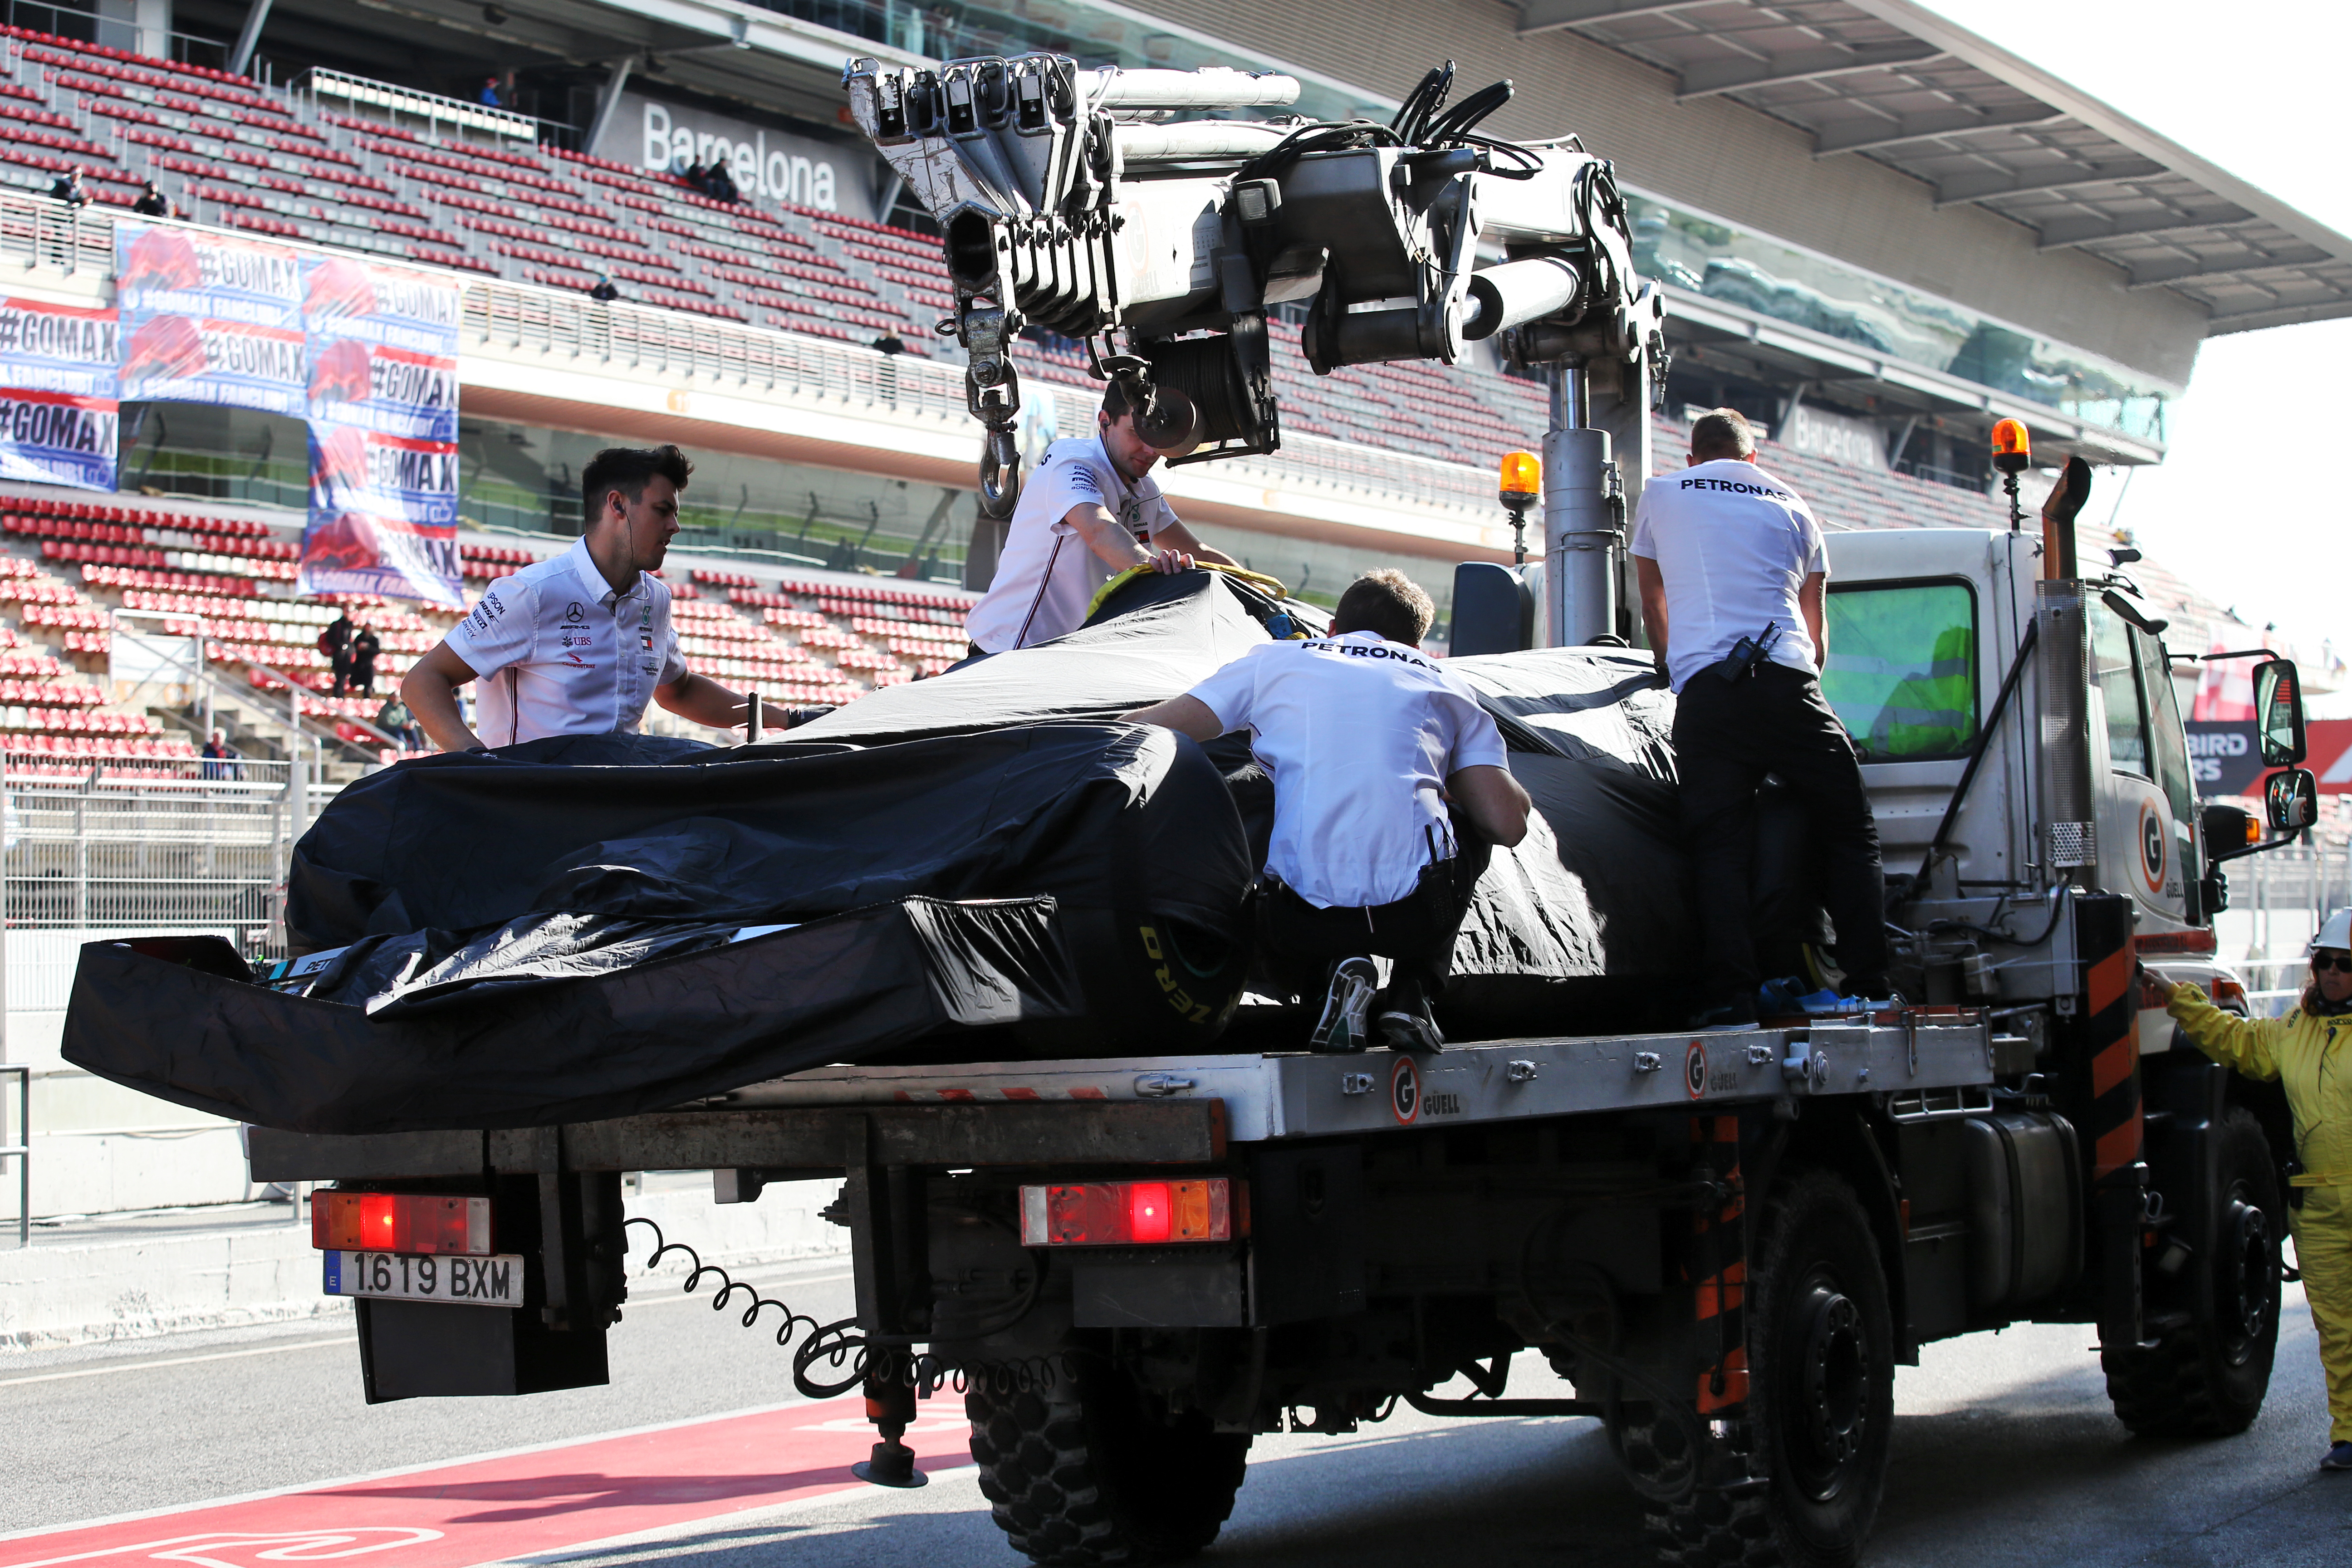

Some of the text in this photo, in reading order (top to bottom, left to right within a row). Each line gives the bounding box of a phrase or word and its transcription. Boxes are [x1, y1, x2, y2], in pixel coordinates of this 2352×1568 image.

[195, 244, 303, 299] #GOMAX
[372, 278, 460, 326] #GOMAX
[0, 308, 118, 363] #GOMAX
[199, 331, 307, 384] #GOMAX
[370, 357, 458, 409] #GOMAX
[0, 398, 114, 456] #GOMAX
[367, 444, 458, 493] #GOMAX
[1681, 479, 1788, 501] PETRONAS
[479, 600, 500, 623] BOSE
[487, 592, 506, 615] EPSON
[573, 637, 592, 646] UBS
[1301, 642, 1442, 674] PETRONAS
[1423, 1090, 1460, 1116] GÜELL
[329, 1276, 337, 1287] E
[354, 1253, 510, 1299] 1619 BXM
